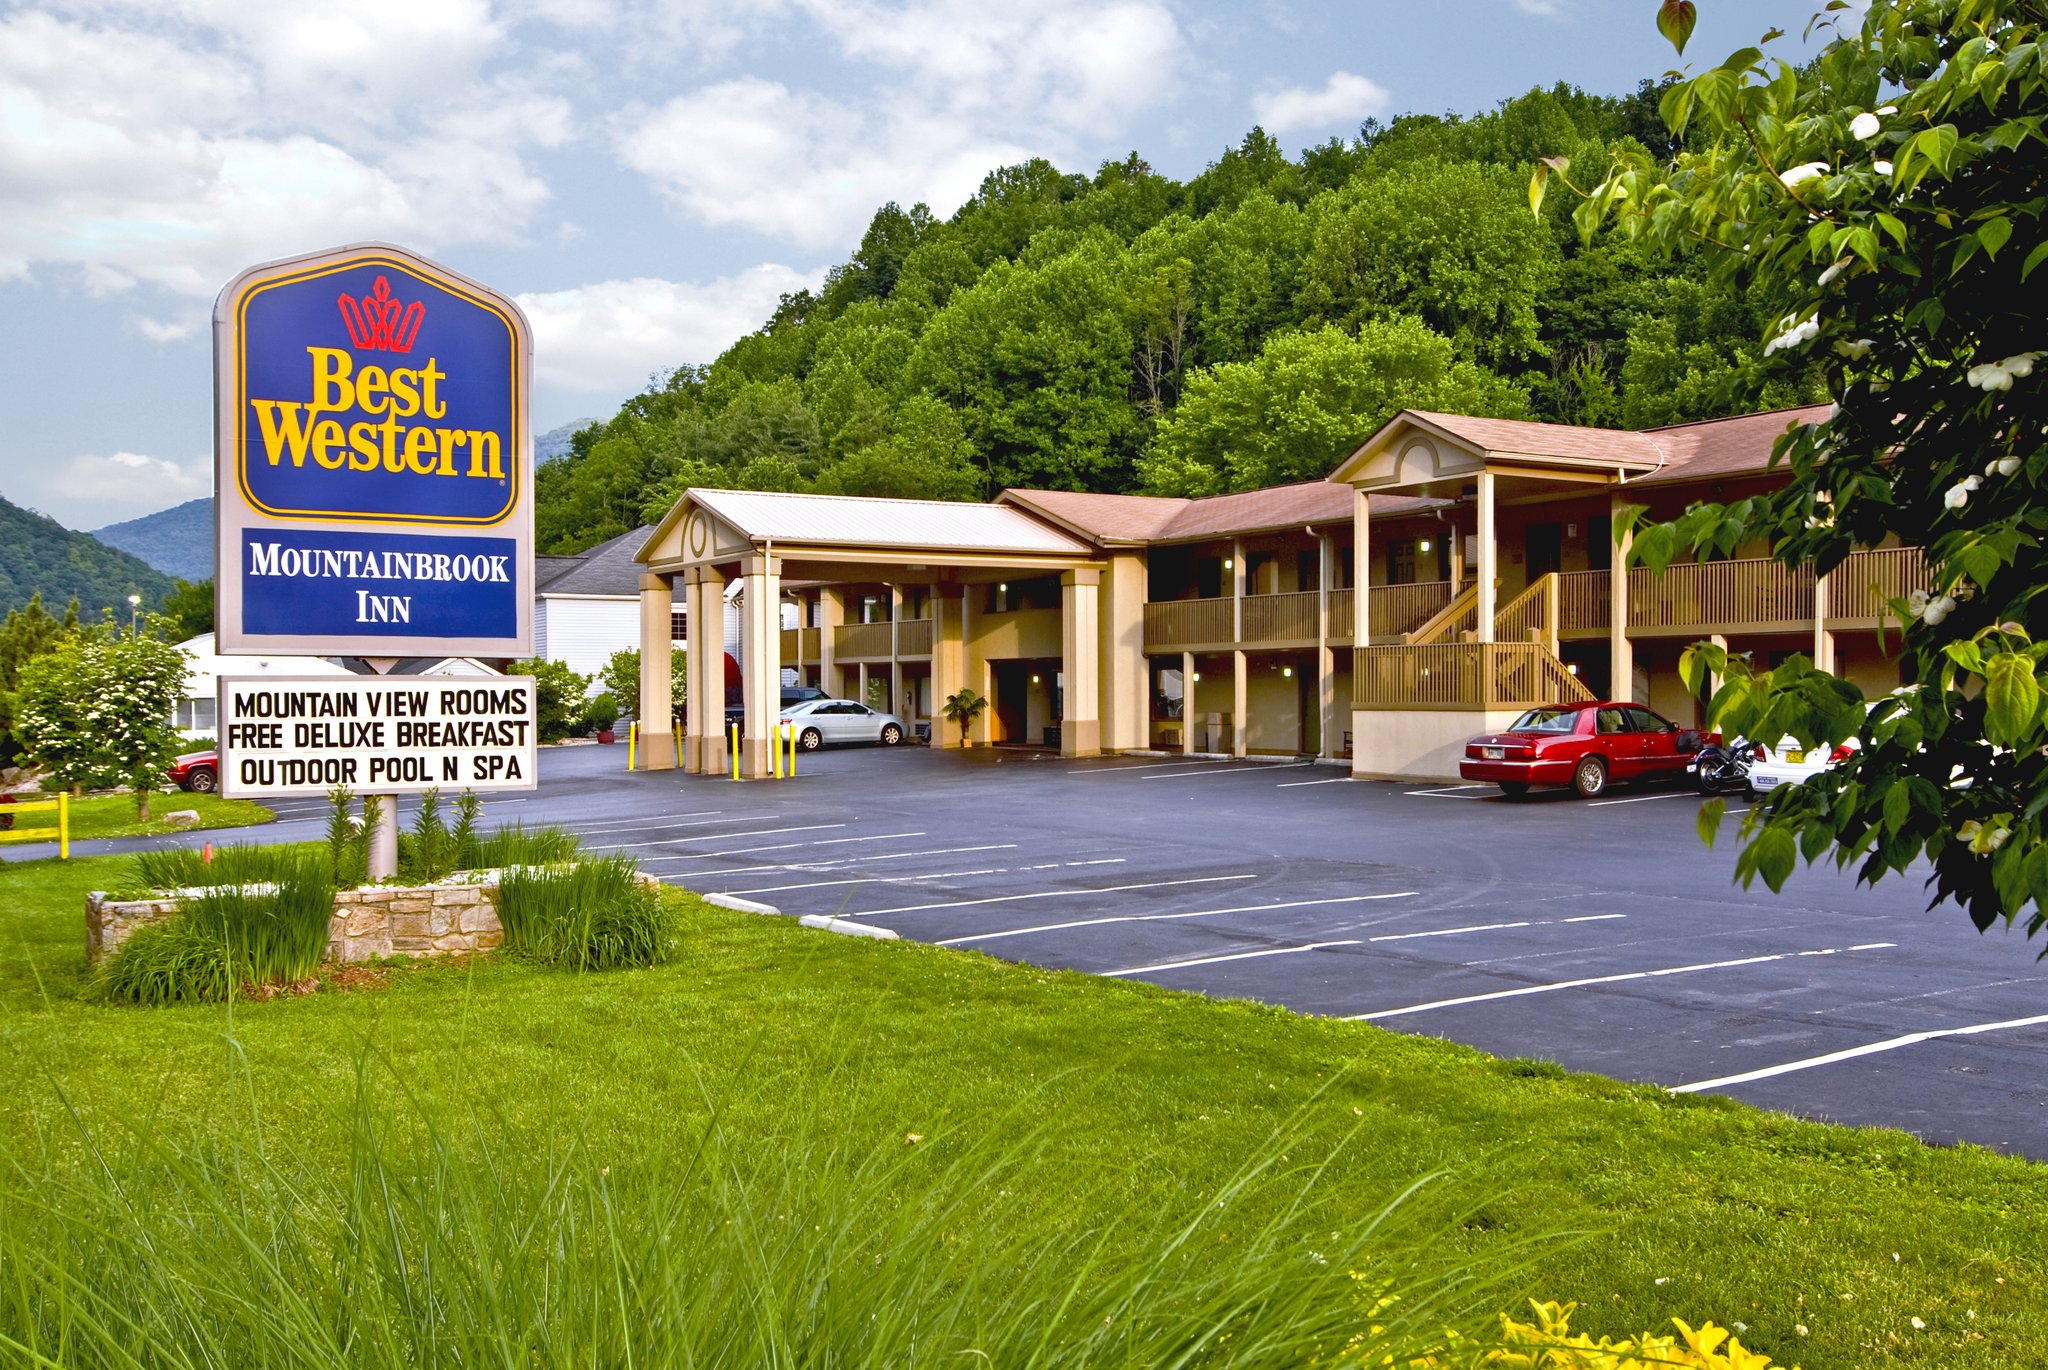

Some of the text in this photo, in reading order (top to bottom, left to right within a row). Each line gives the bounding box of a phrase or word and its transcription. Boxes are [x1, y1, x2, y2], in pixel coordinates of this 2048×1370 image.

[307, 346, 446, 419] Best
[250, 399, 506, 479] Western
[249, 542, 510, 582] MOUNTAINBROOK
[355, 590, 411, 623] INN
[235, 689, 527, 718] MOUNTAIN VIEW ROOMS
[228, 720, 529, 749] FREE DELUXE BREAKFAST
[241, 755, 522, 786] OUTDOOR POOL N SPA
